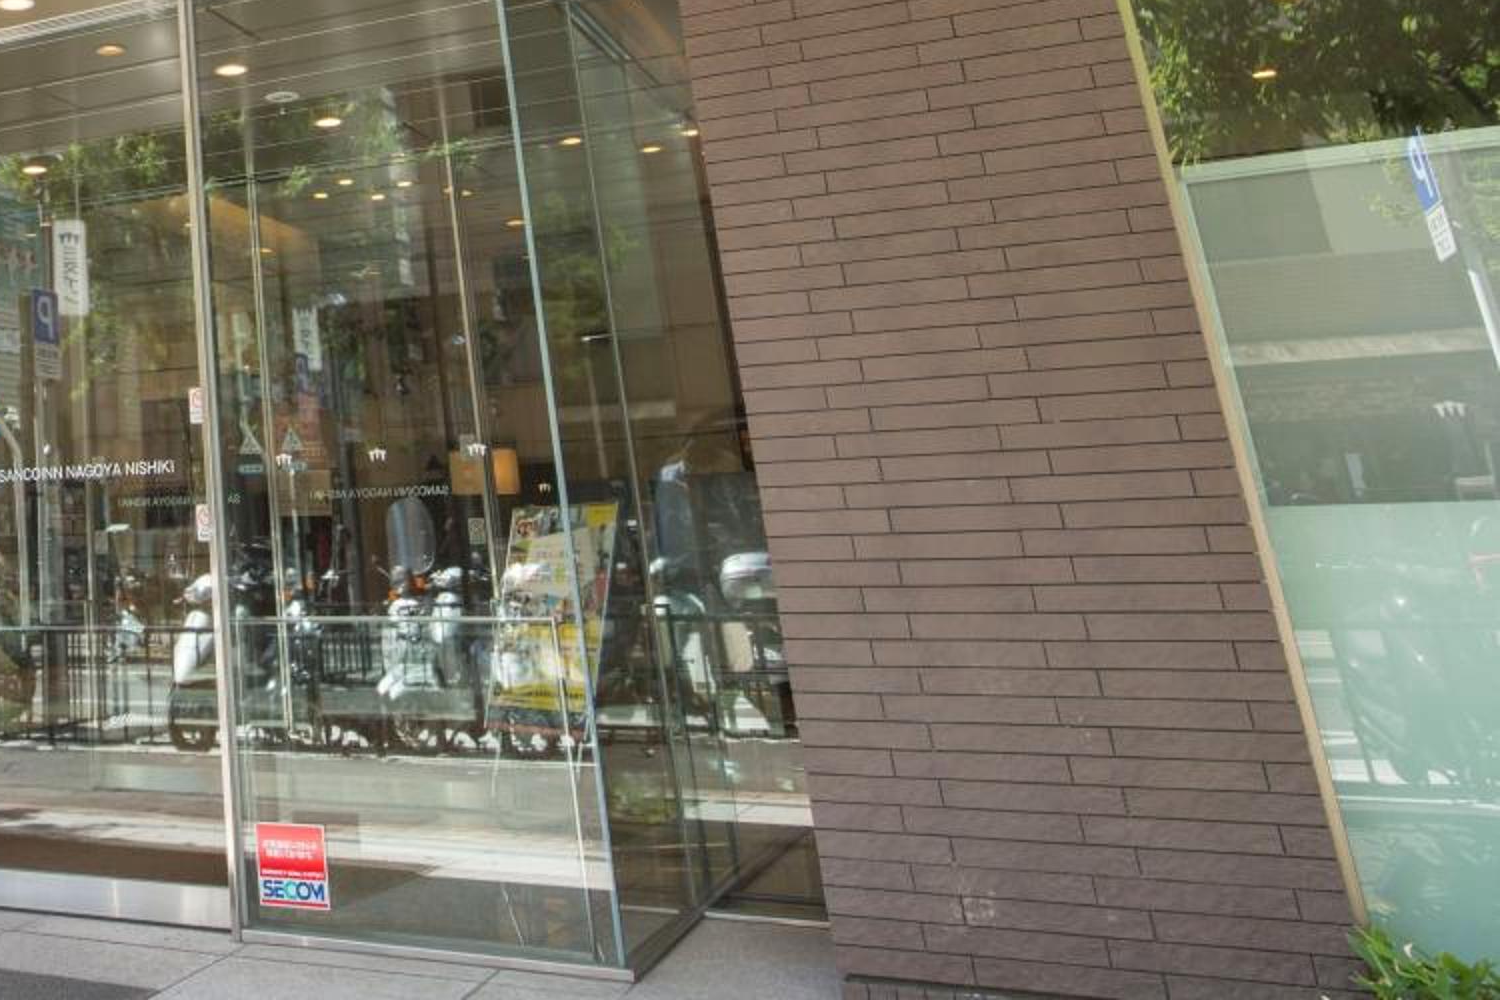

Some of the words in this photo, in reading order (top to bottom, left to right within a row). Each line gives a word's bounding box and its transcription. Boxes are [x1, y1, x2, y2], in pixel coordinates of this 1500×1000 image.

[65, 463, 121, 480] NAGOYA
[125, 459, 176, 476] NISHIKI
[263, 880, 324, 901] SECOM
